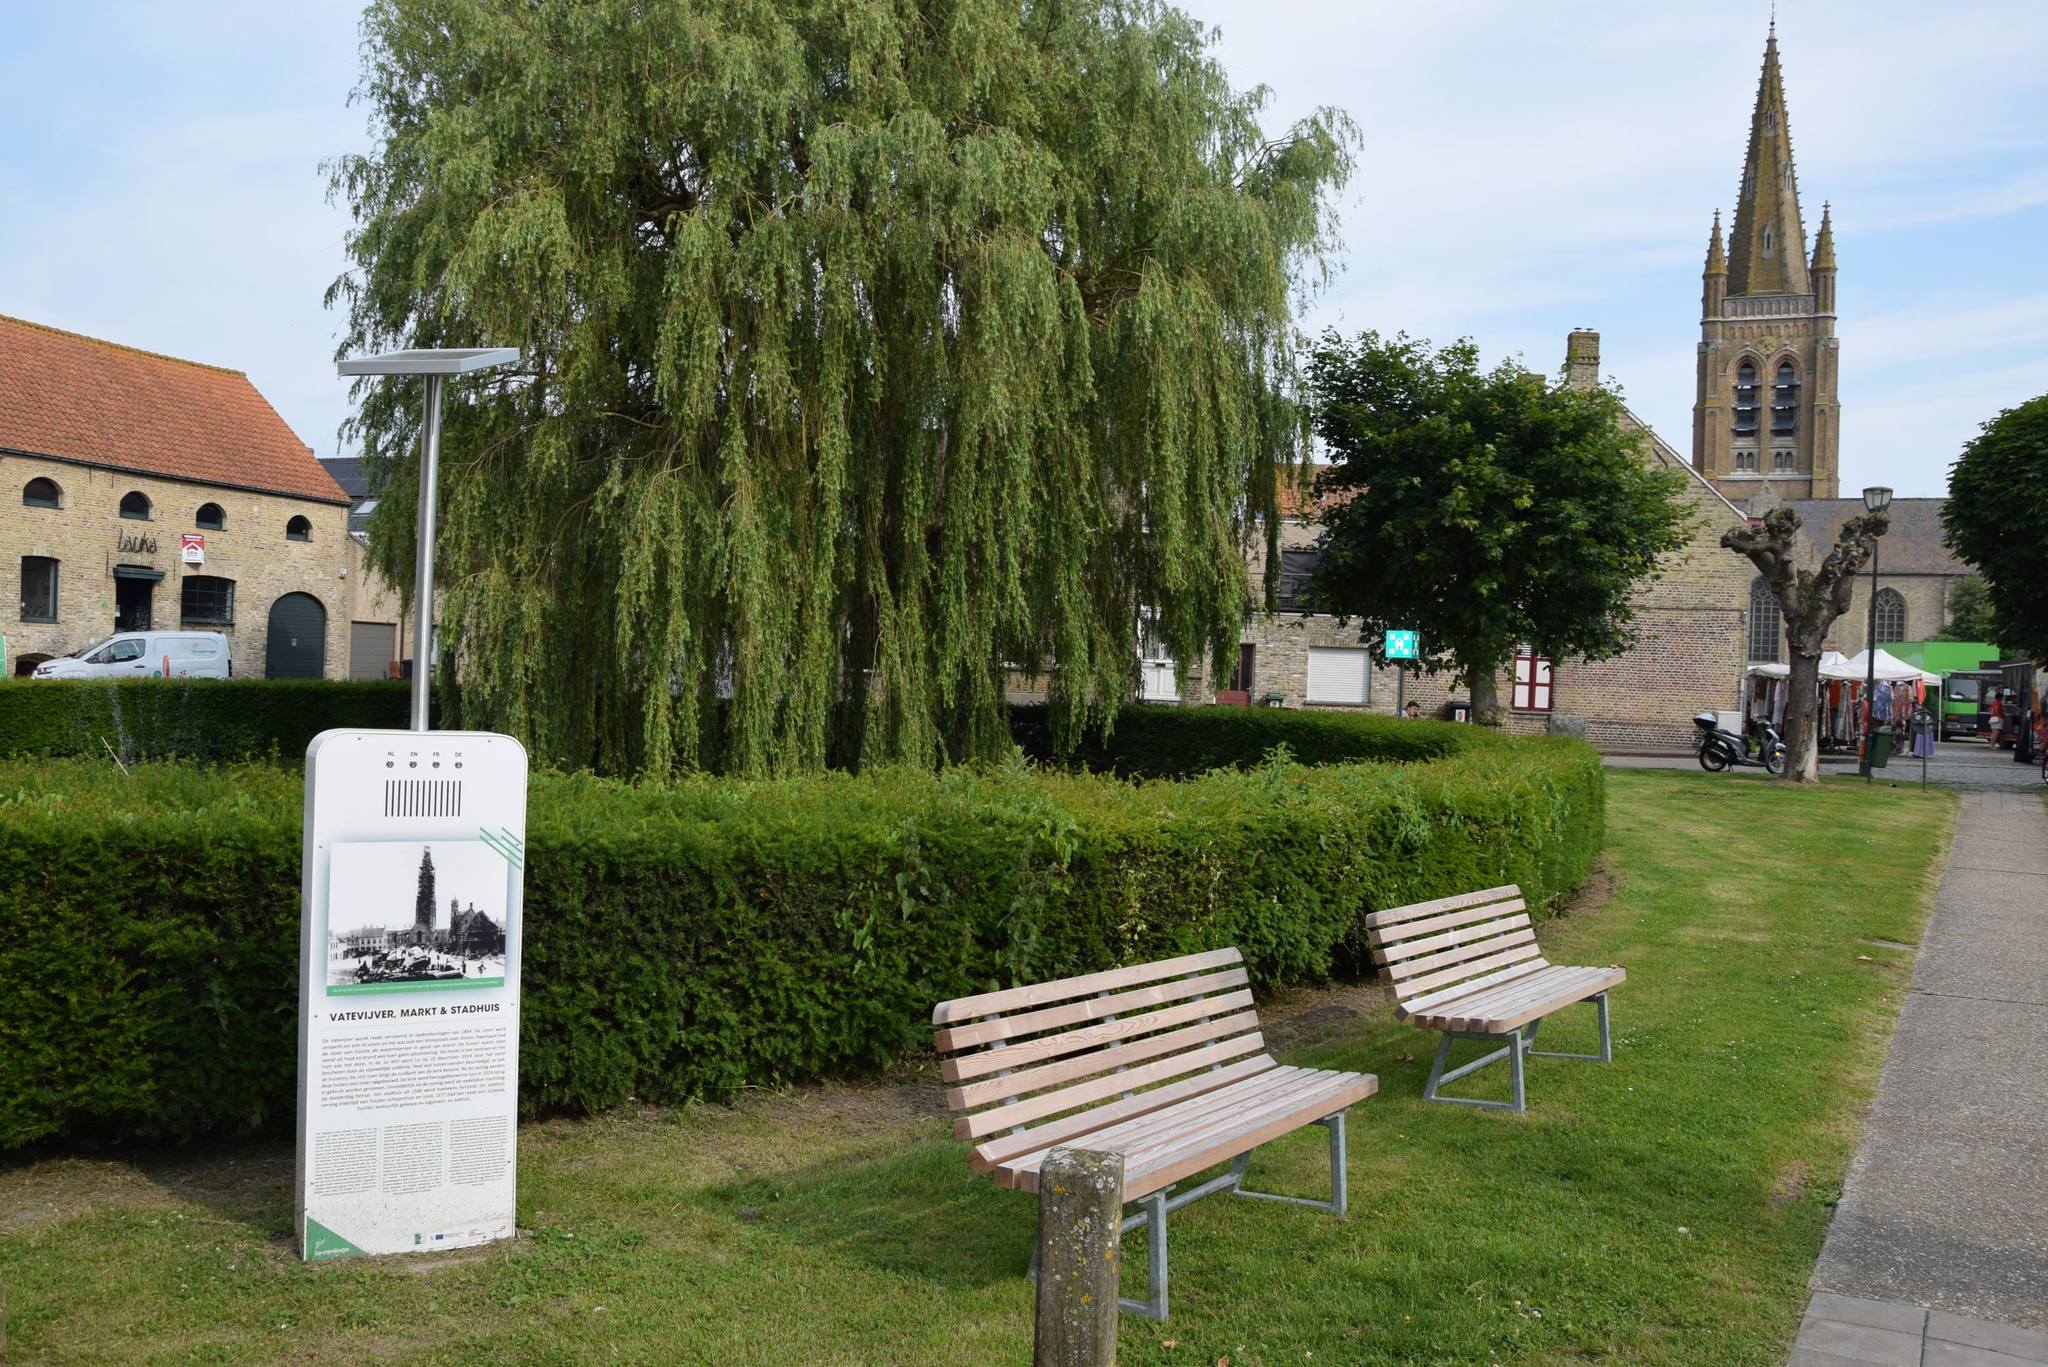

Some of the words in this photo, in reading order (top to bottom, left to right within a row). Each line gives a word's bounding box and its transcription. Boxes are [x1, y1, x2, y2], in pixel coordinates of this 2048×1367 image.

[330, 1009, 396, 1022] VATEVIJVER,
[400, 1007, 437, 1017] MARKT
[440, 1006, 447, 1015] &
[450, 1003, 500, 1014] STADHUIS
